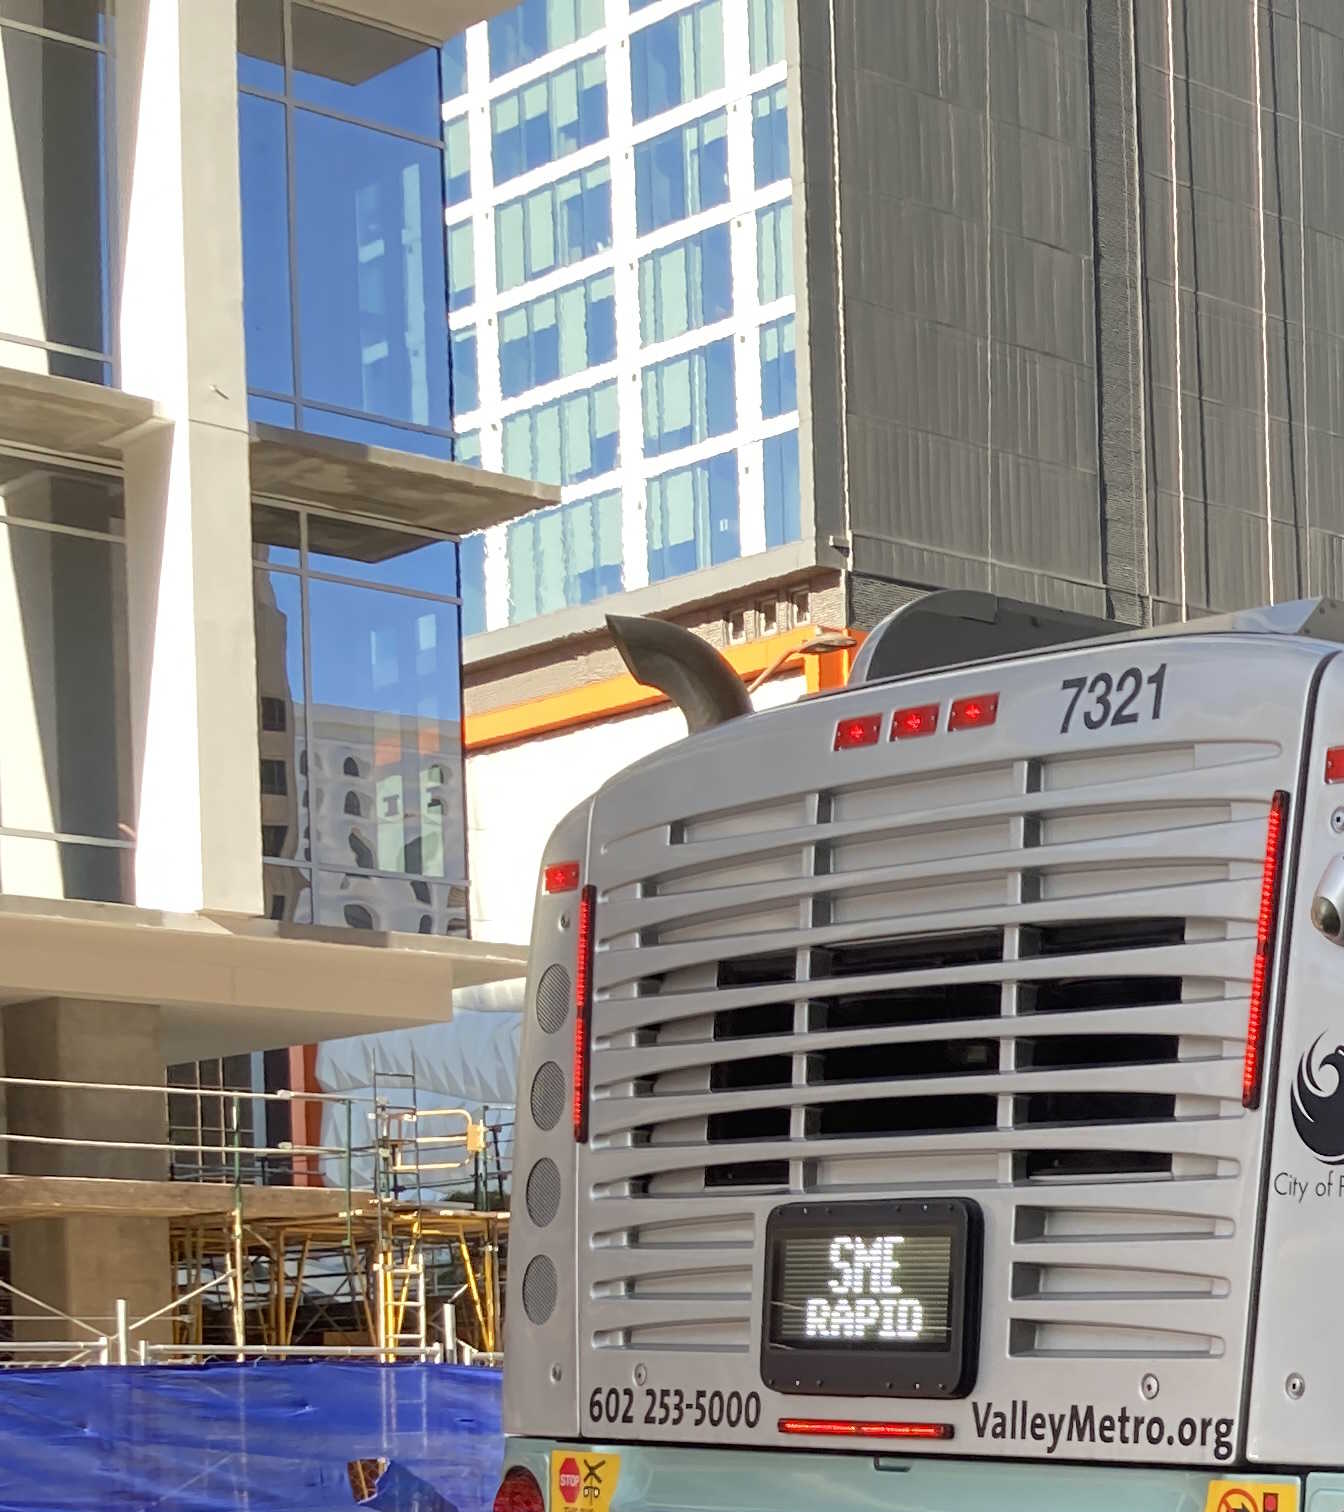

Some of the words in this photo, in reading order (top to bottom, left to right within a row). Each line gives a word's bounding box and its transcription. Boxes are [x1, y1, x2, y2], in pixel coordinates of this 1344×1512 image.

[1061, 662, 1167, 734] 7321
[1274, 1171, 1308, 1204] City
[1315, 1170, 1333, 1197] of
[828, 1236, 904, 1294] SME
[805, 1298, 923, 1337] RAPID
[589, 1387, 634, 1424] 602
[644, 1388, 762, 1429] 253-5000
[972, 1400, 1234, 1461] ValleyMetro.org
[560, 1474, 580, 1487] STOP
